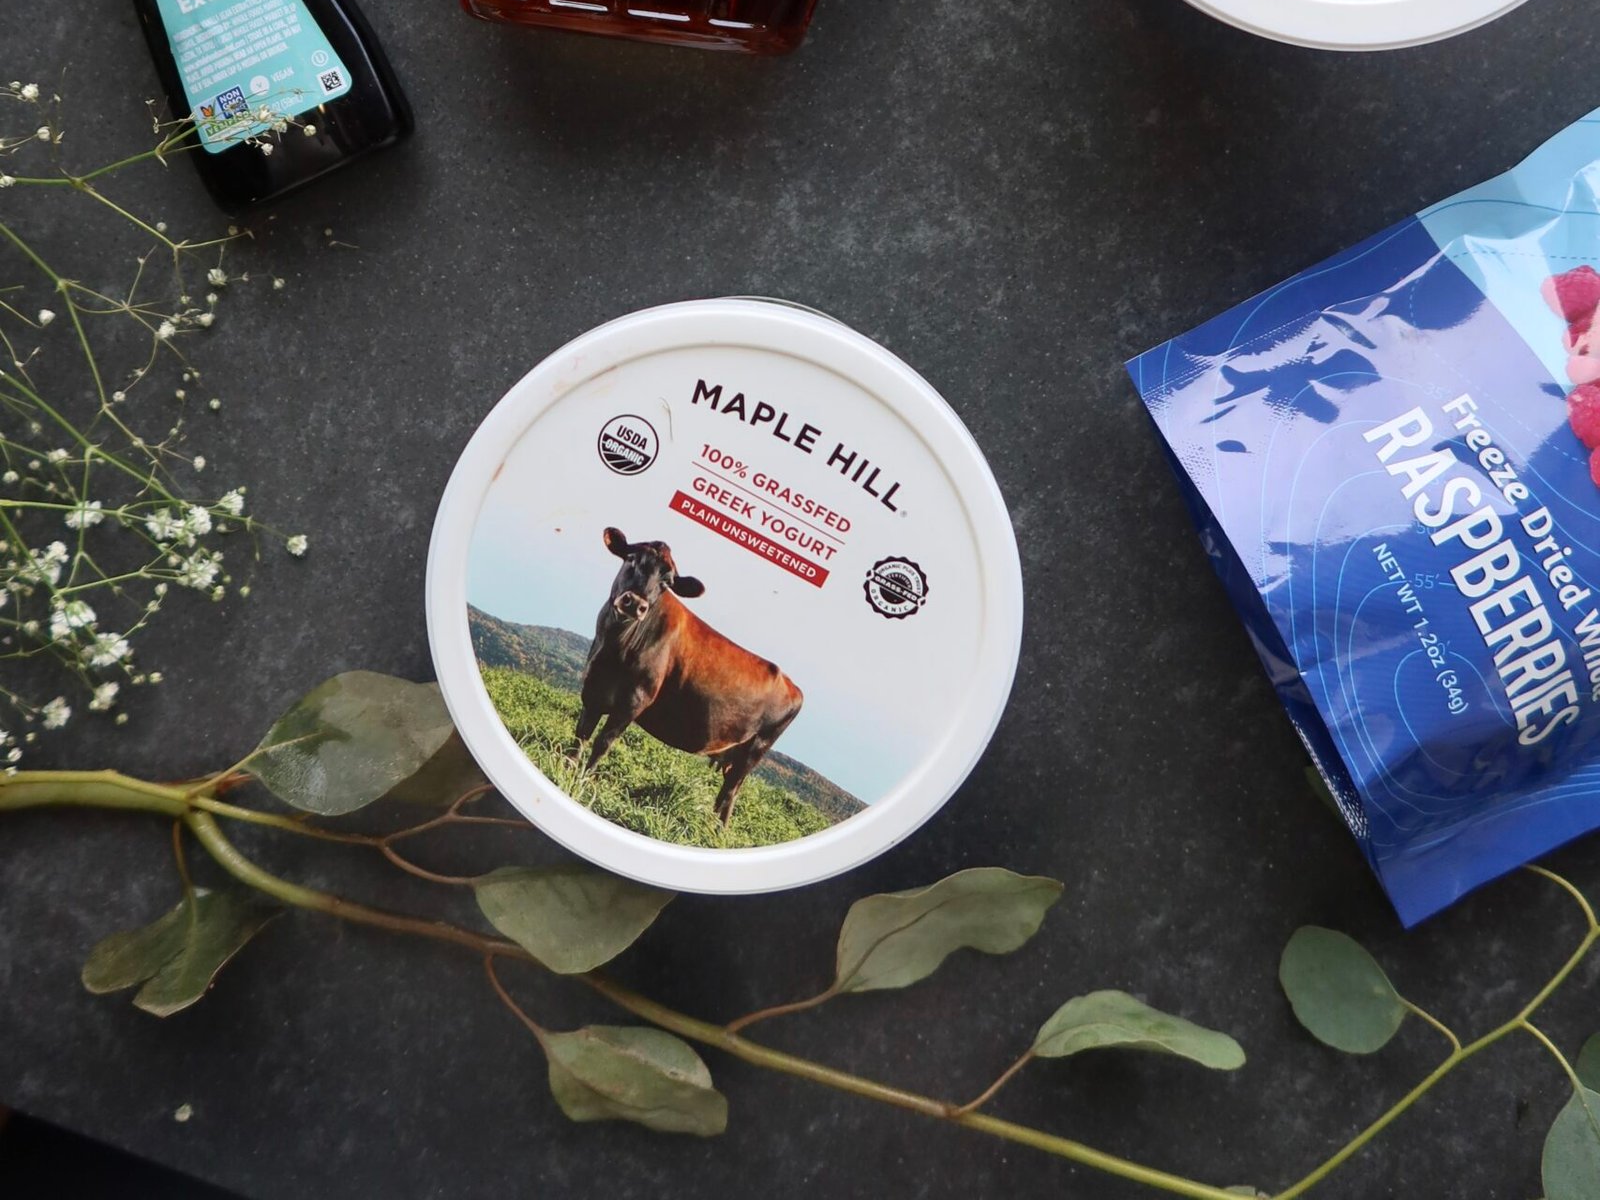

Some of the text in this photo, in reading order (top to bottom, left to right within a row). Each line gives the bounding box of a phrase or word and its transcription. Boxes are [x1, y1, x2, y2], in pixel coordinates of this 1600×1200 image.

[206, 111, 250, 135] VEIFD
[219, 89, 240, 104] NON
[605, 439, 644, 466] ORGANIC
[617, 425, 647, 450] USDA
[691, 378, 904, 512] MAPLE HILL
[700, 444, 851, 533] 100% GRASSFED
[1442, 393, 1529, 505] Freeze
[1520, 506, 1591, 611] Dried
[681, 500, 817, 579] PLAIN UNSWEETENED
[692, 477, 837, 562] GREEK YOGURT
[874, 576, 918, 601] GRASS-FED
[878, 564, 901, 574] ORGANIC
[1362, 406, 1580, 746] RASPBERRIES
[871, 588, 908, 612] ORGANIC
[1373, 543, 1405, 580] NET
[1397, 583, 1423, 614] WT
[1414, 618, 1445, 668] 1.2oz
[1436, 670, 1468, 714] (34g)
